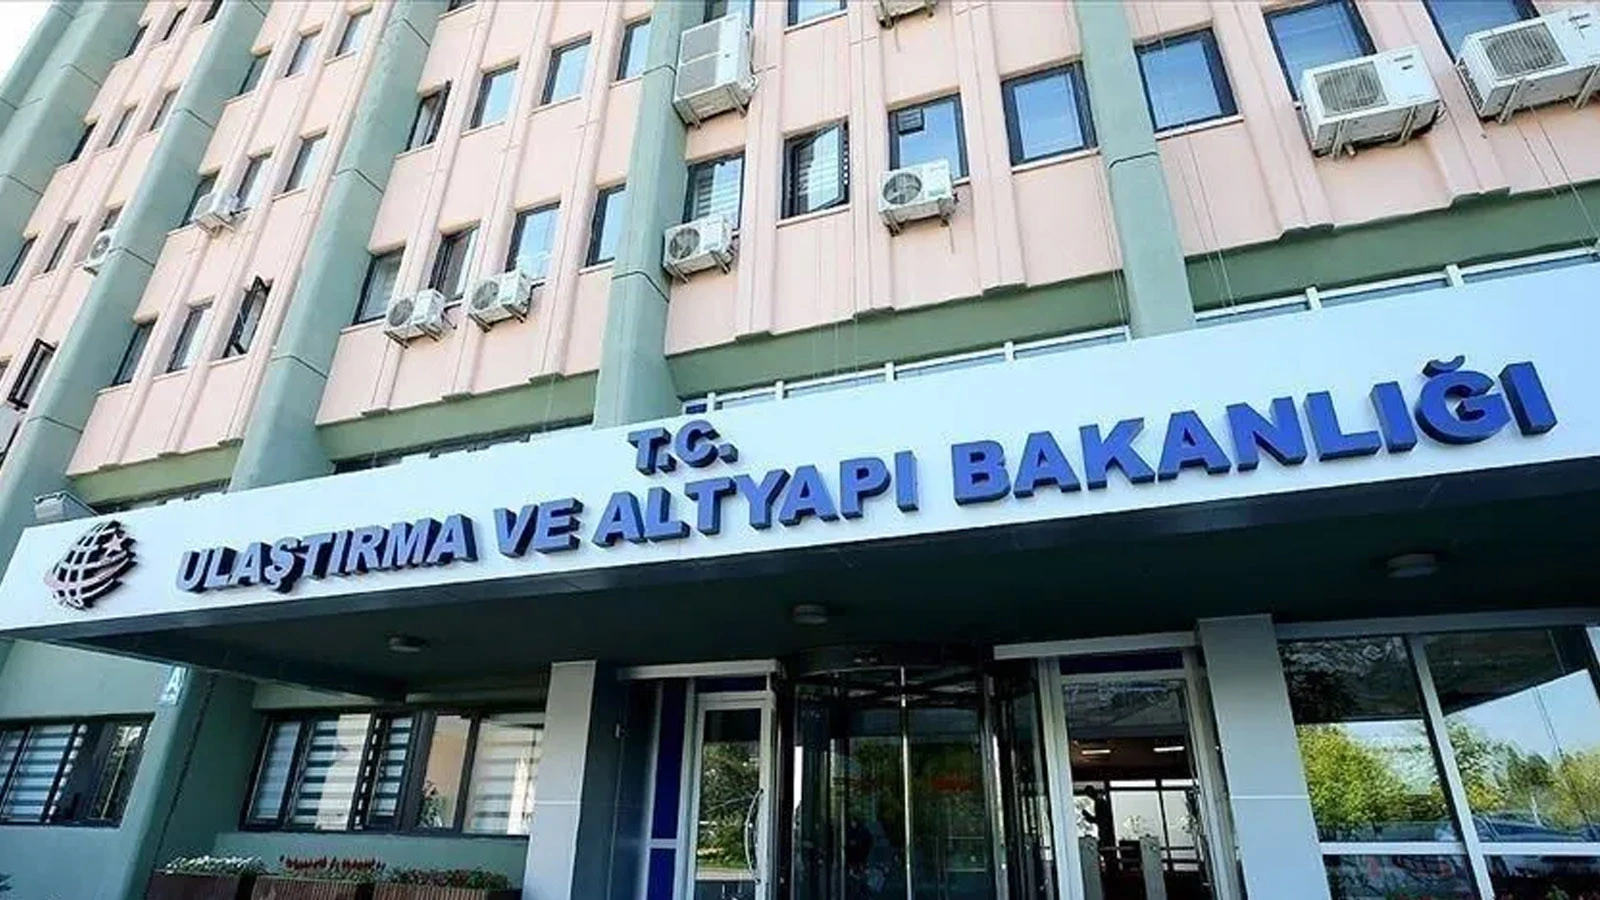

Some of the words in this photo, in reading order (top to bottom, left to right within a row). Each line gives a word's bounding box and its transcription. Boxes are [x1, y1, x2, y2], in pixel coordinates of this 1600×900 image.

[176, 513, 479, 593] ULAŞTIRMA
[493, 497, 584, 558] VE
[592, 450, 919, 547] ALTYAPI
[951, 355, 1558, 506] BAKANLIĞI
[627, 419, 739, 476] T.C.
